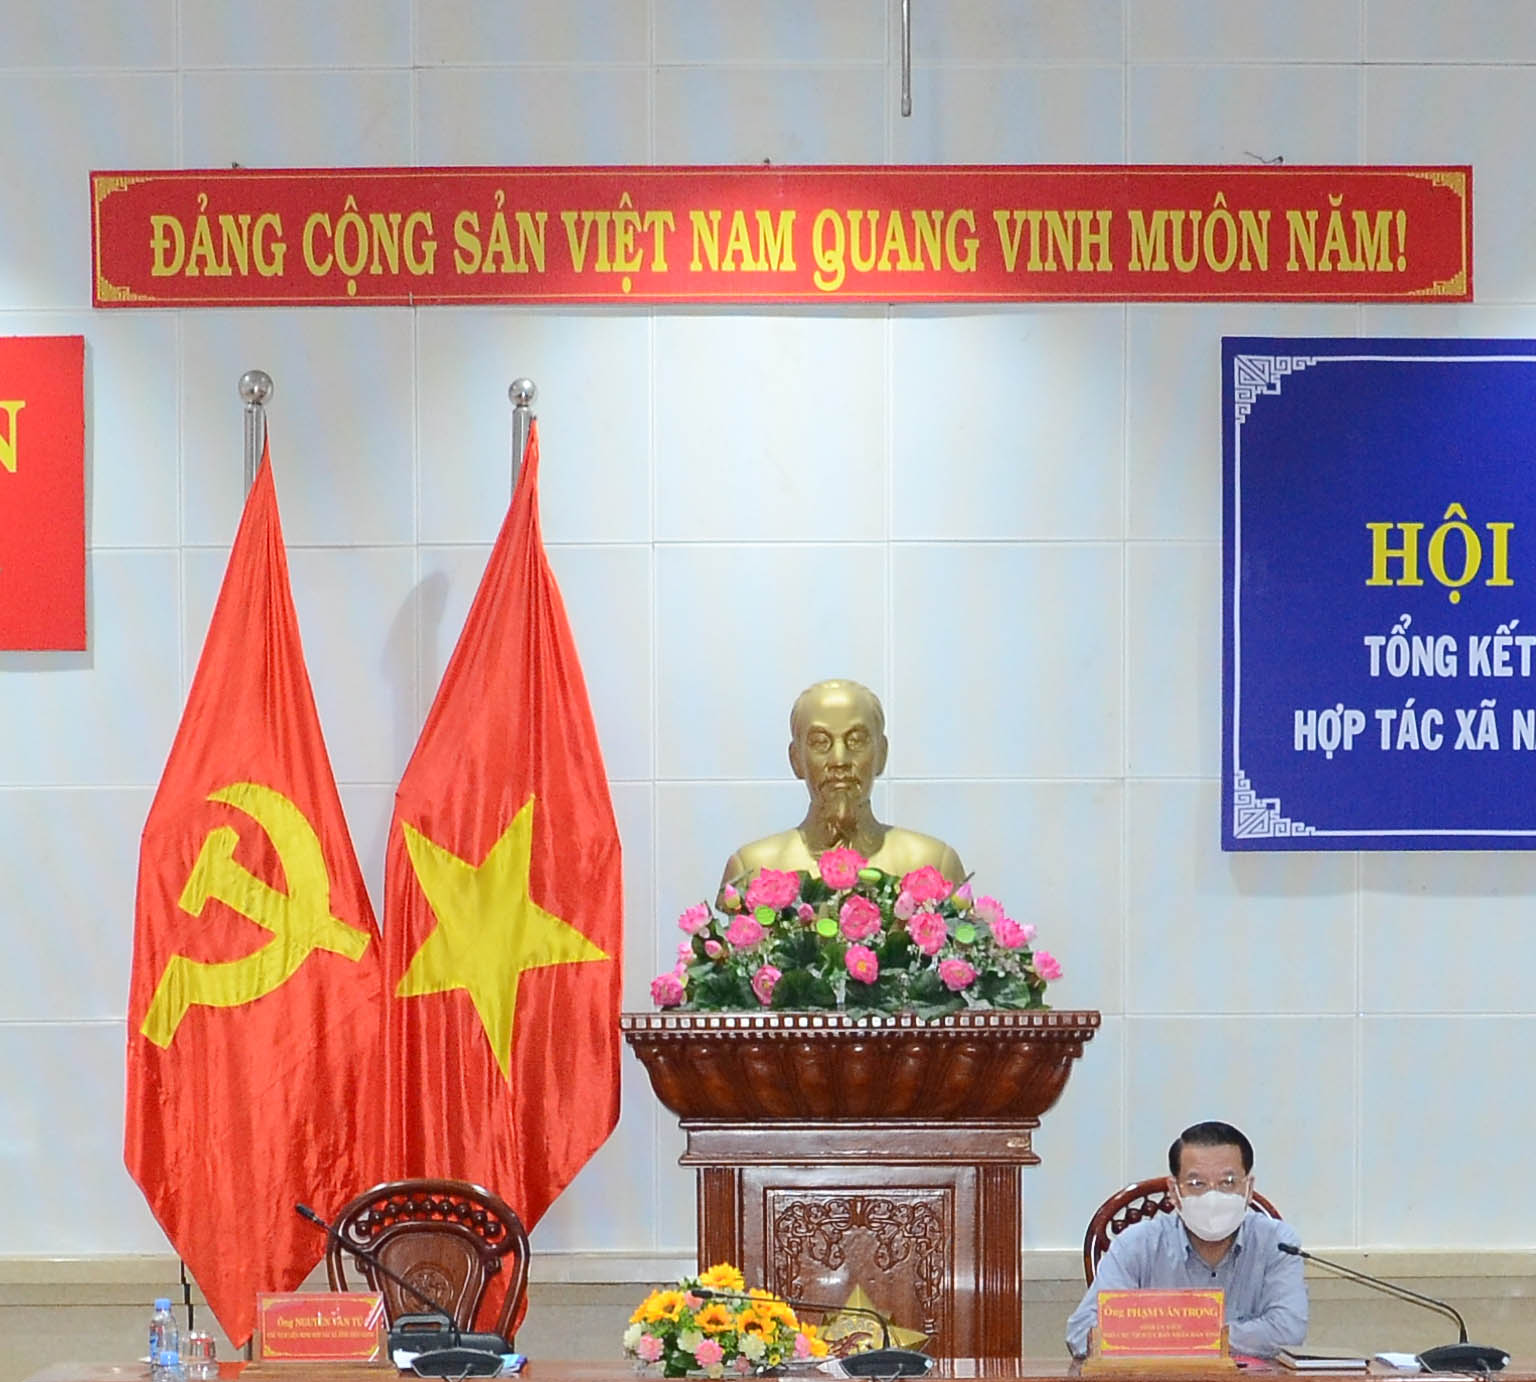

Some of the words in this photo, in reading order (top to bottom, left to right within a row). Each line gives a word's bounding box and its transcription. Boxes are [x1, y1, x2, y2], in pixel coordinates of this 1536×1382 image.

[150, 192, 286, 277] ĐẢNG
[302, 194, 436, 297] CỘNG
[453, 191, 547, 274] SẢN
[561, 192, 676, 292] VIỆT
[690, 209, 796, 273] NAM
[811, 208, 980, 293] QUANG
[992, 209, 1113, 273] VINH
[1129, 192, 1271, 273] MUÔN
[1286, 193, 1407, 272] NĂM!
[1367, 502, 1514, 604] HỘI
[1363, 613, 1458, 678] TỔNG
[1468, 619, 1536, 677] KẾT
[1294, 703, 1366, 760] HỢP
[1375, 698, 1443, 751] TÁC
[1454, 699, 1500, 751] XÃ
